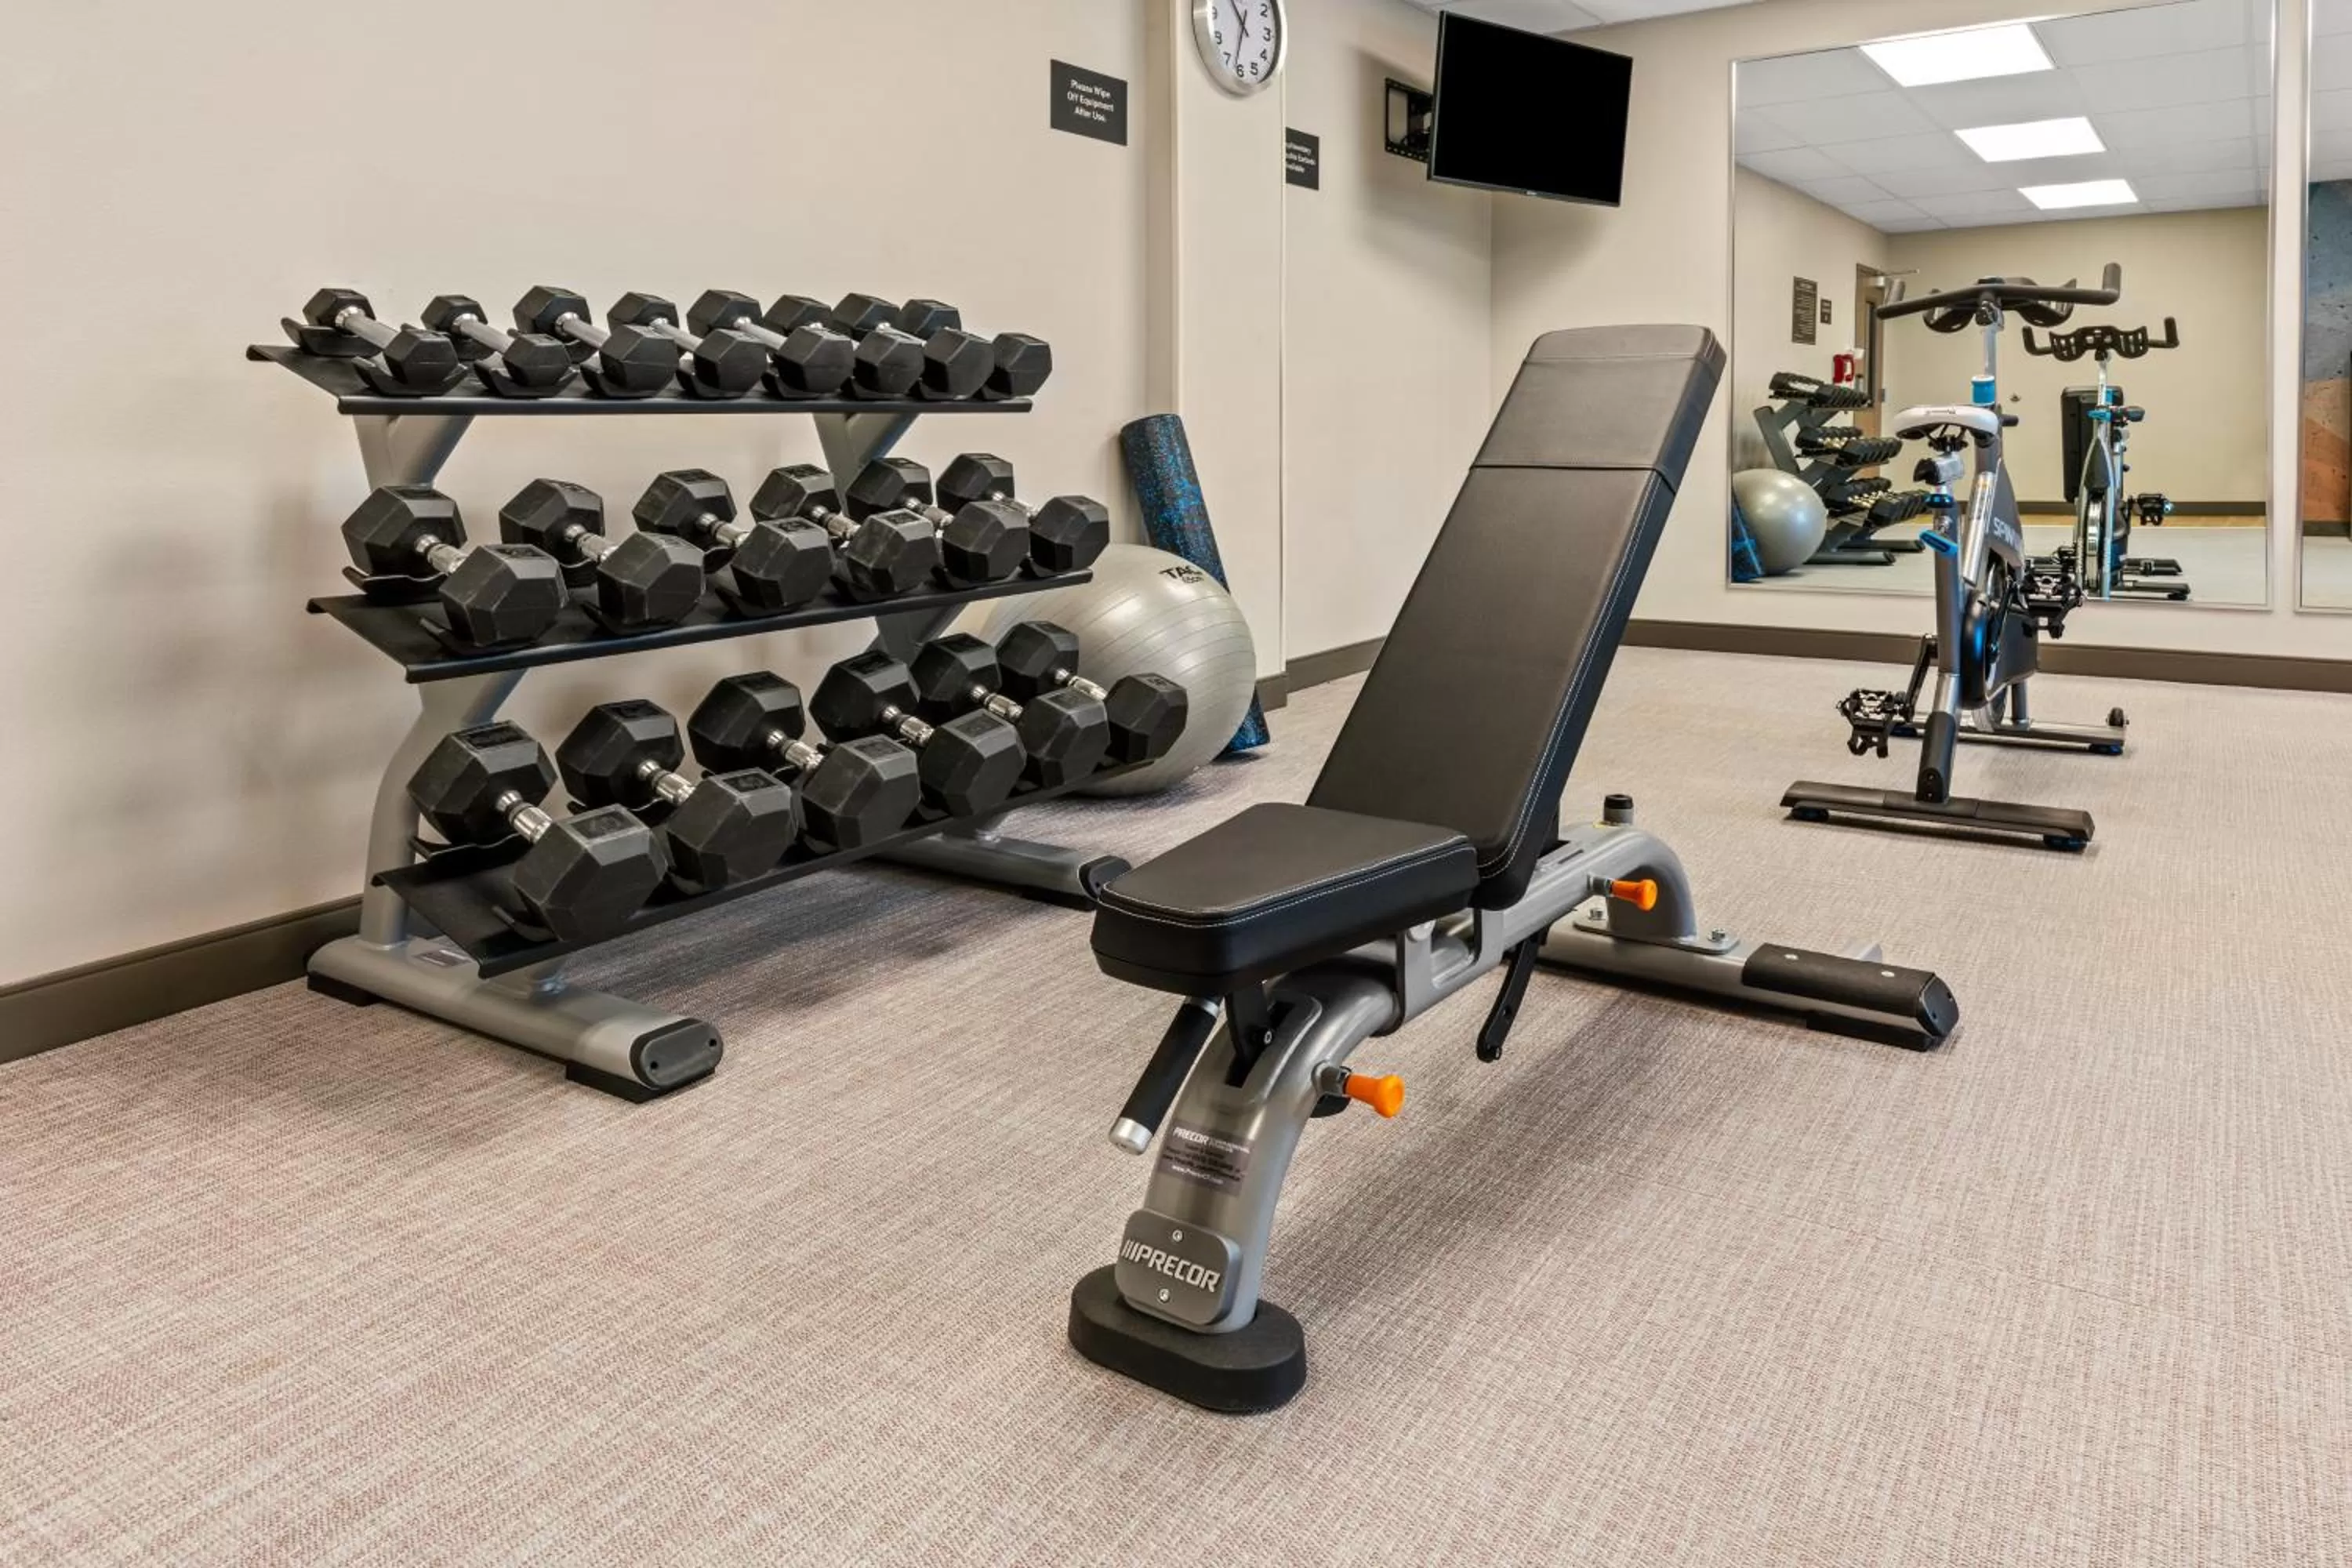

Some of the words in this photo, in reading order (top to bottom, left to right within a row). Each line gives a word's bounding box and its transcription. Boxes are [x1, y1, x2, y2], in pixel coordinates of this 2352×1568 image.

[1260, 3, 1268, 17] 2
[1263, 27, 1271, 42] 3
[1223, 52, 1231, 66] 7
[1260, 49, 1267, 61] 4
[1236, 64, 1244, 78] 6
[1250, 62, 1258, 75] 5
[1070, 79, 1093, 93] Please
[1067, 90, 1079, 103] Off
[1080, 94, 1113, 112] Equipment
[1173, 1127, 1209, 1145] PRECOR
[1134, 1243, 1221, 1293] PRECOR
